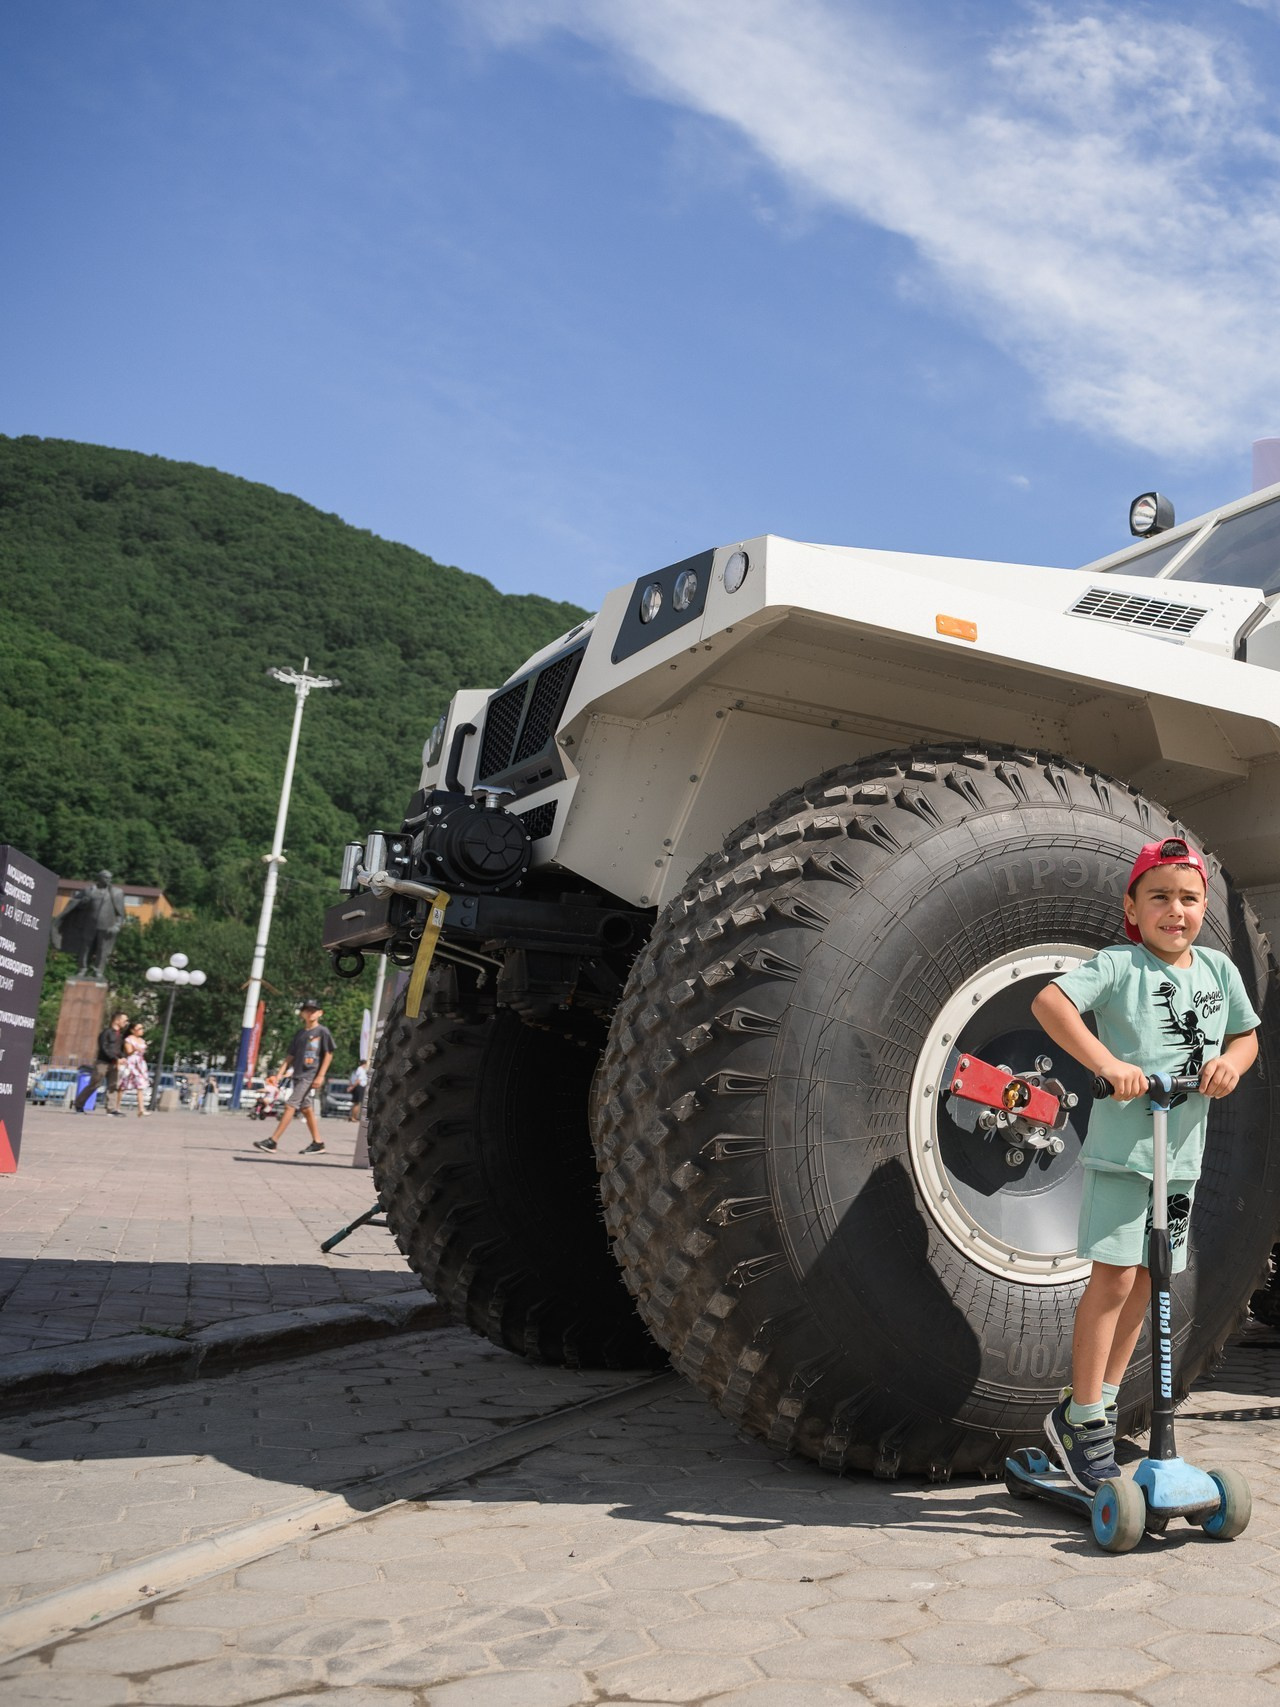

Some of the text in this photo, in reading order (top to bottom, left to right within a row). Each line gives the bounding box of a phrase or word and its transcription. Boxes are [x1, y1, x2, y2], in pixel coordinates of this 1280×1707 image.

[6, 863, 36, 890] МОЩНОСТЬ
[993, 855, 1125, 899] ТРЭК
[4, 881, 33, 906] ДВИГАТЕЛЯ
[0, 936, 17, 954] ТРАНА-
[0, 954, 34, 978] ОИЗВОДИТЕЛЬ
[0, 975, 14, 992] ОНИЯ
